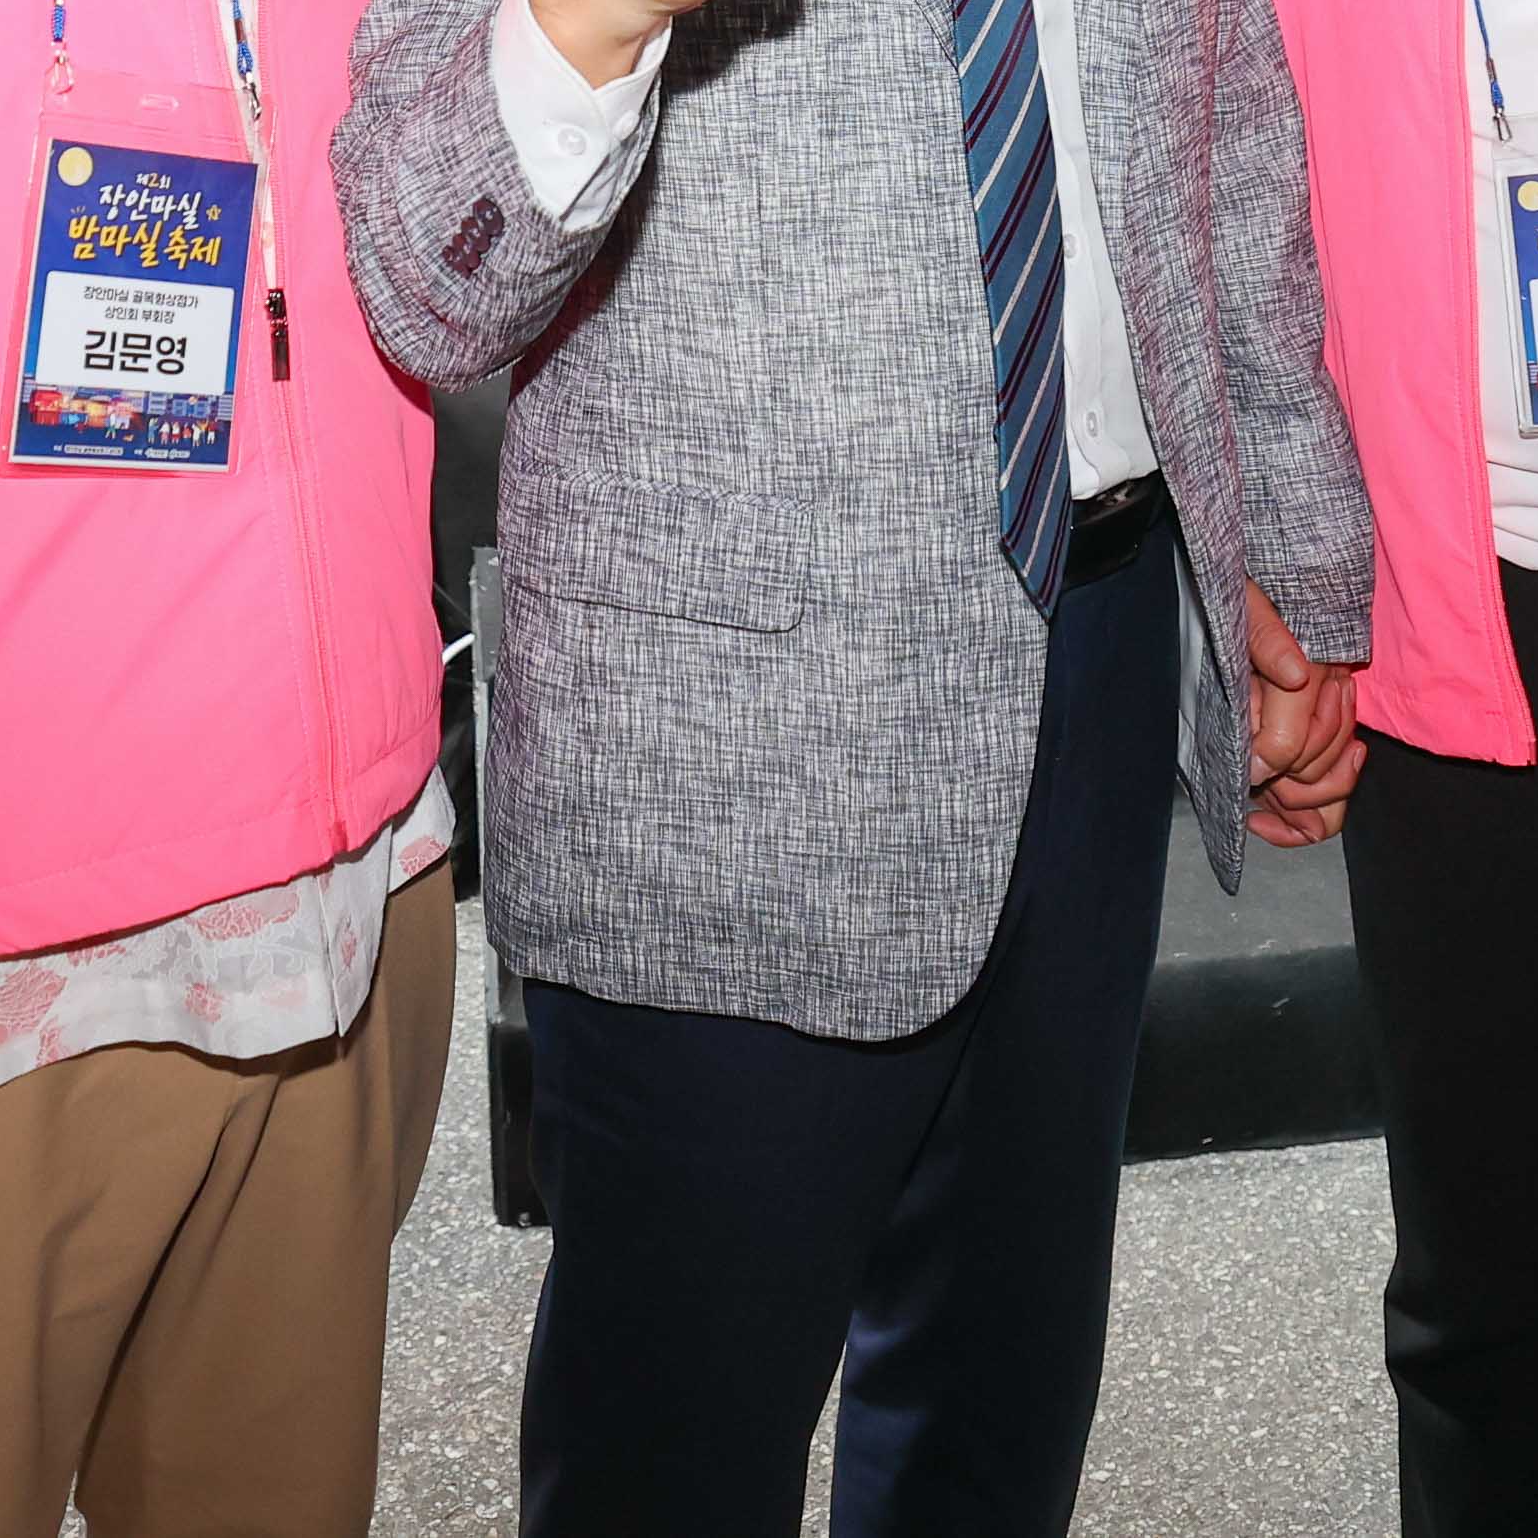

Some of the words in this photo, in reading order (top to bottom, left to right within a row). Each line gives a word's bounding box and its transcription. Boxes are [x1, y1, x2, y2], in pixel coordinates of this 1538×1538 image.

[136, 172, 171, 190] 제2회
[98, 183, 203, 230] 장안마실
[82, 286, 129, 304] 장안마실
[104, 305, 139, 322] 상인회
[141, 308, 176, 325] 부회장
[83, 329, 188, 377] 김문영
